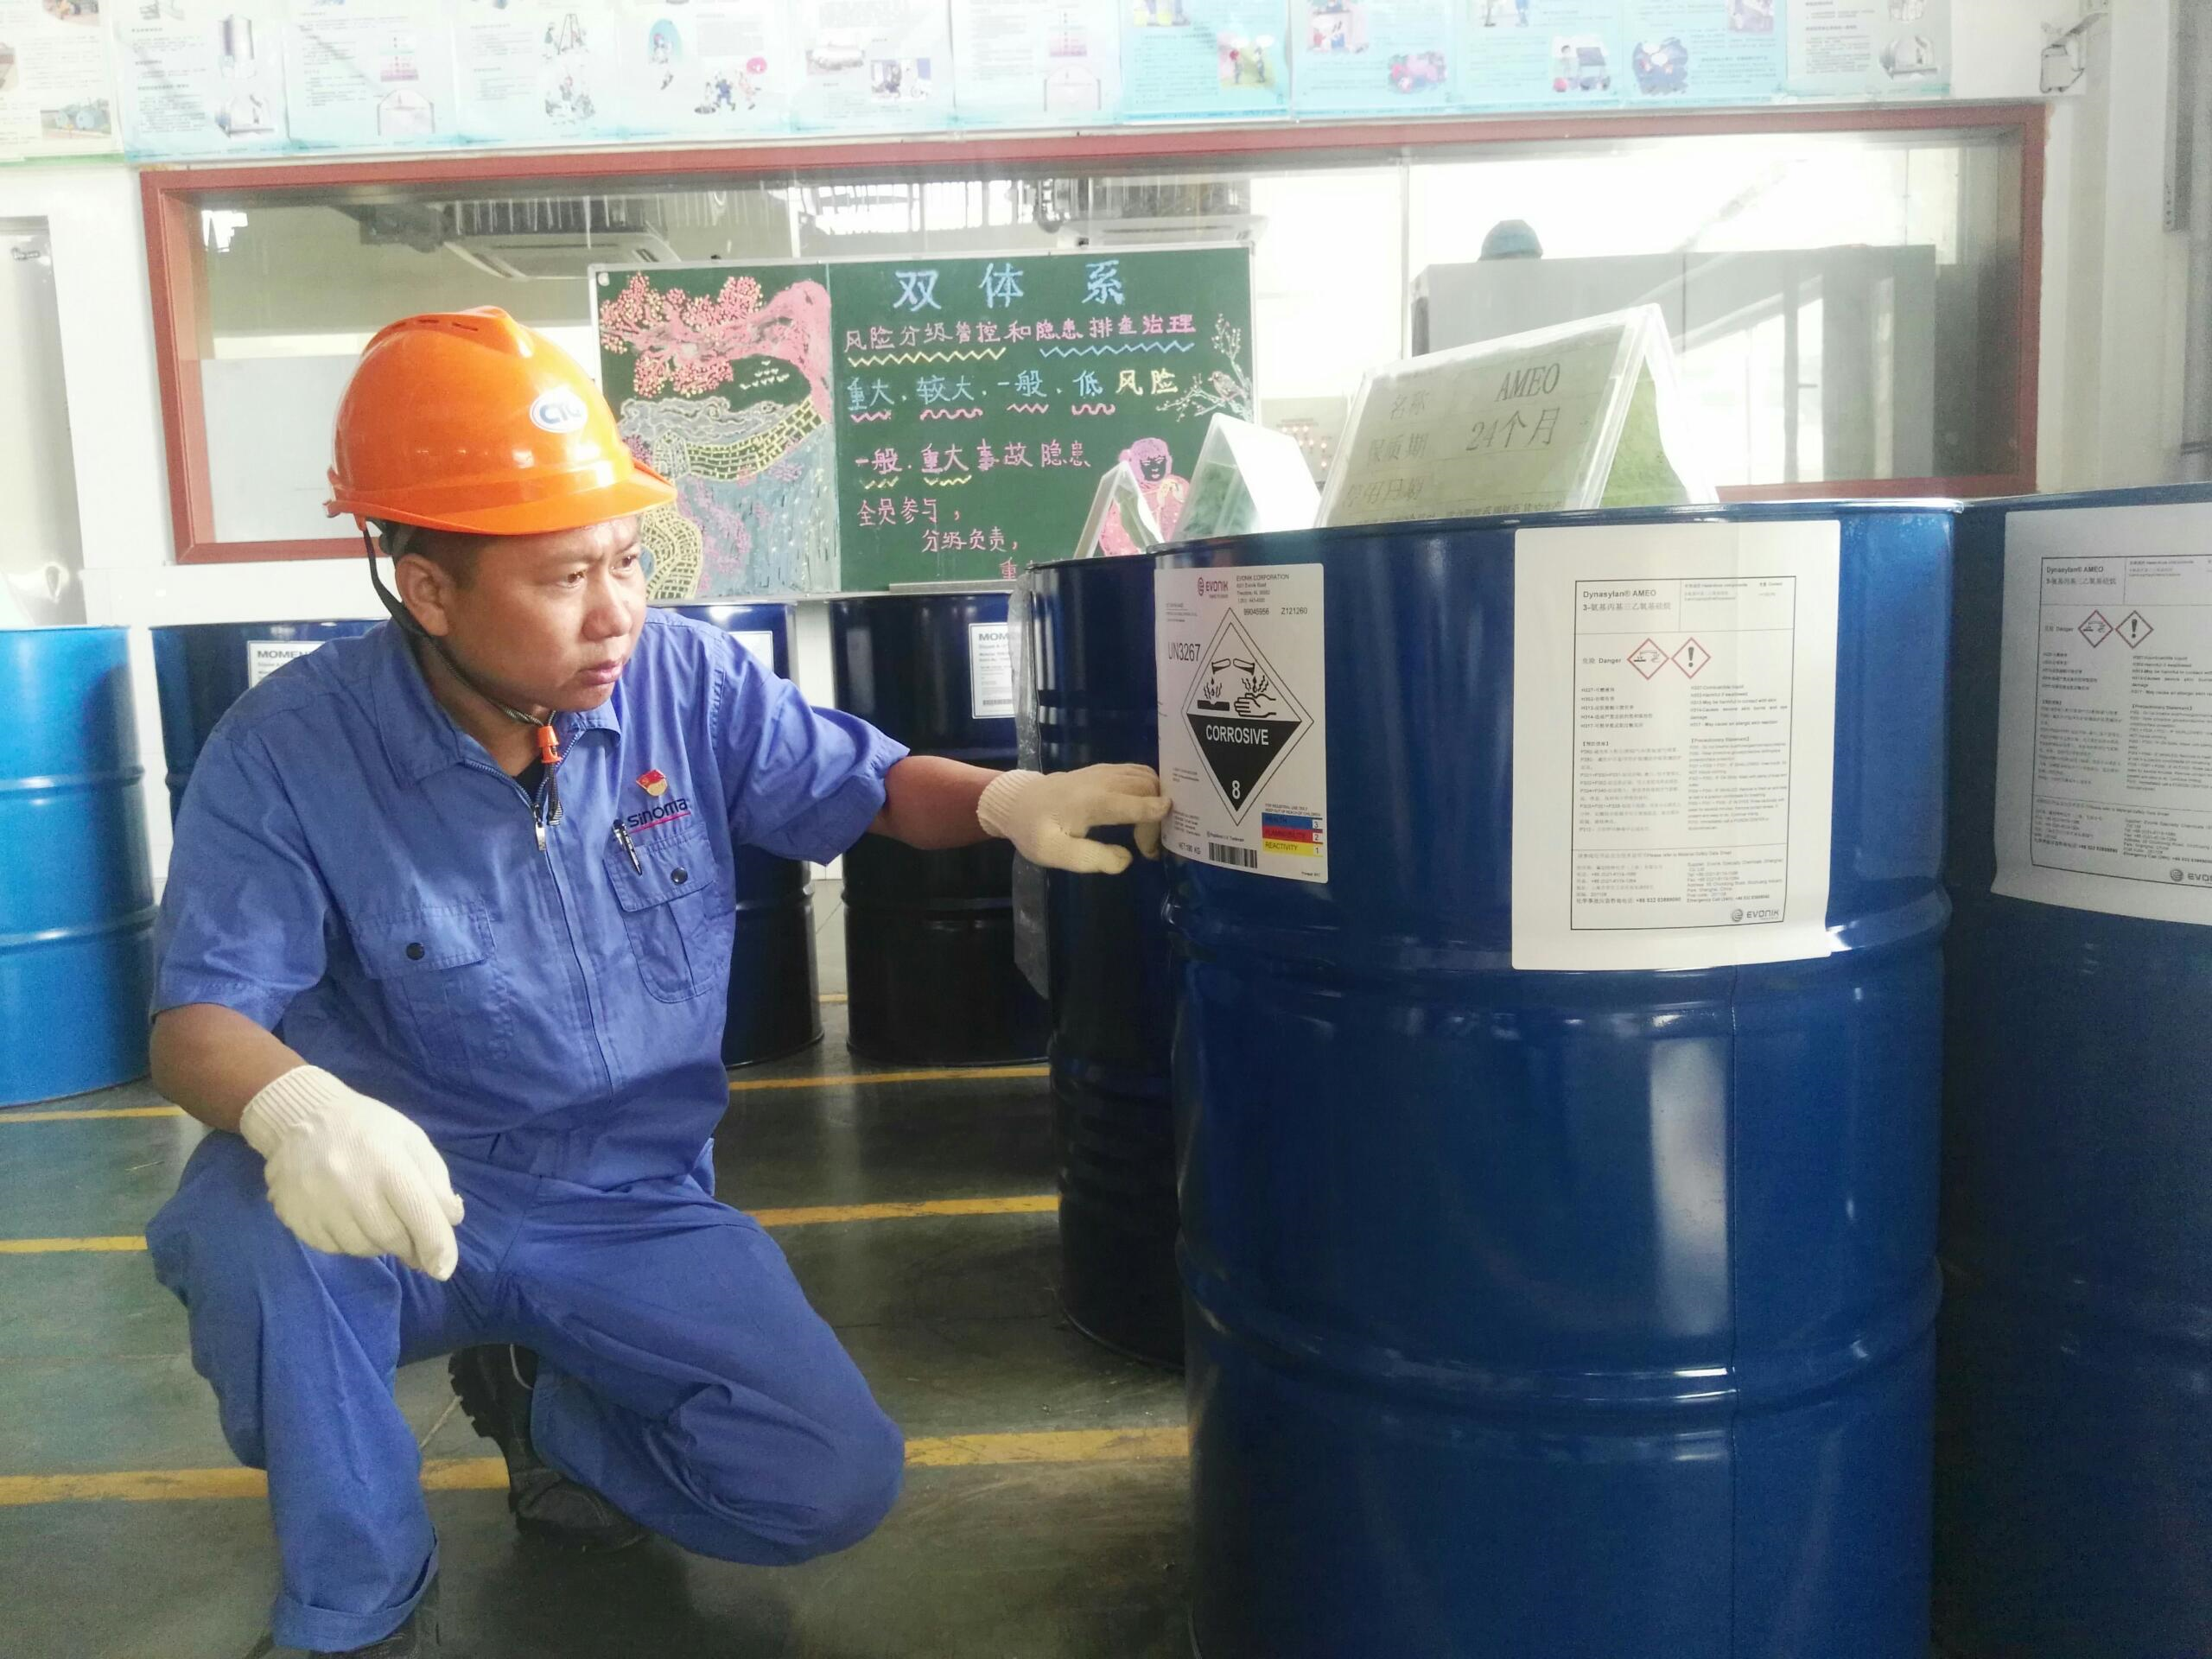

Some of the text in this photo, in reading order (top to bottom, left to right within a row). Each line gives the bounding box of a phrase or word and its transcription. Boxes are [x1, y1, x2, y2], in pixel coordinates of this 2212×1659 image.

[1494, 363, 1560, 403] AMEO
[1465, 406, 1560, 451] 24个月
[1205, 580, 1229, 593] EVONIK
[1168, 642, 1201, 662] UN3267
[1205, 724, 1269, 746] CORROSIVE
[1232, 780, 1241, 799] 8
[1265, 841, 1299, 851] REACTIVITY
[1746, 909, 1779, 918] EVONIK
